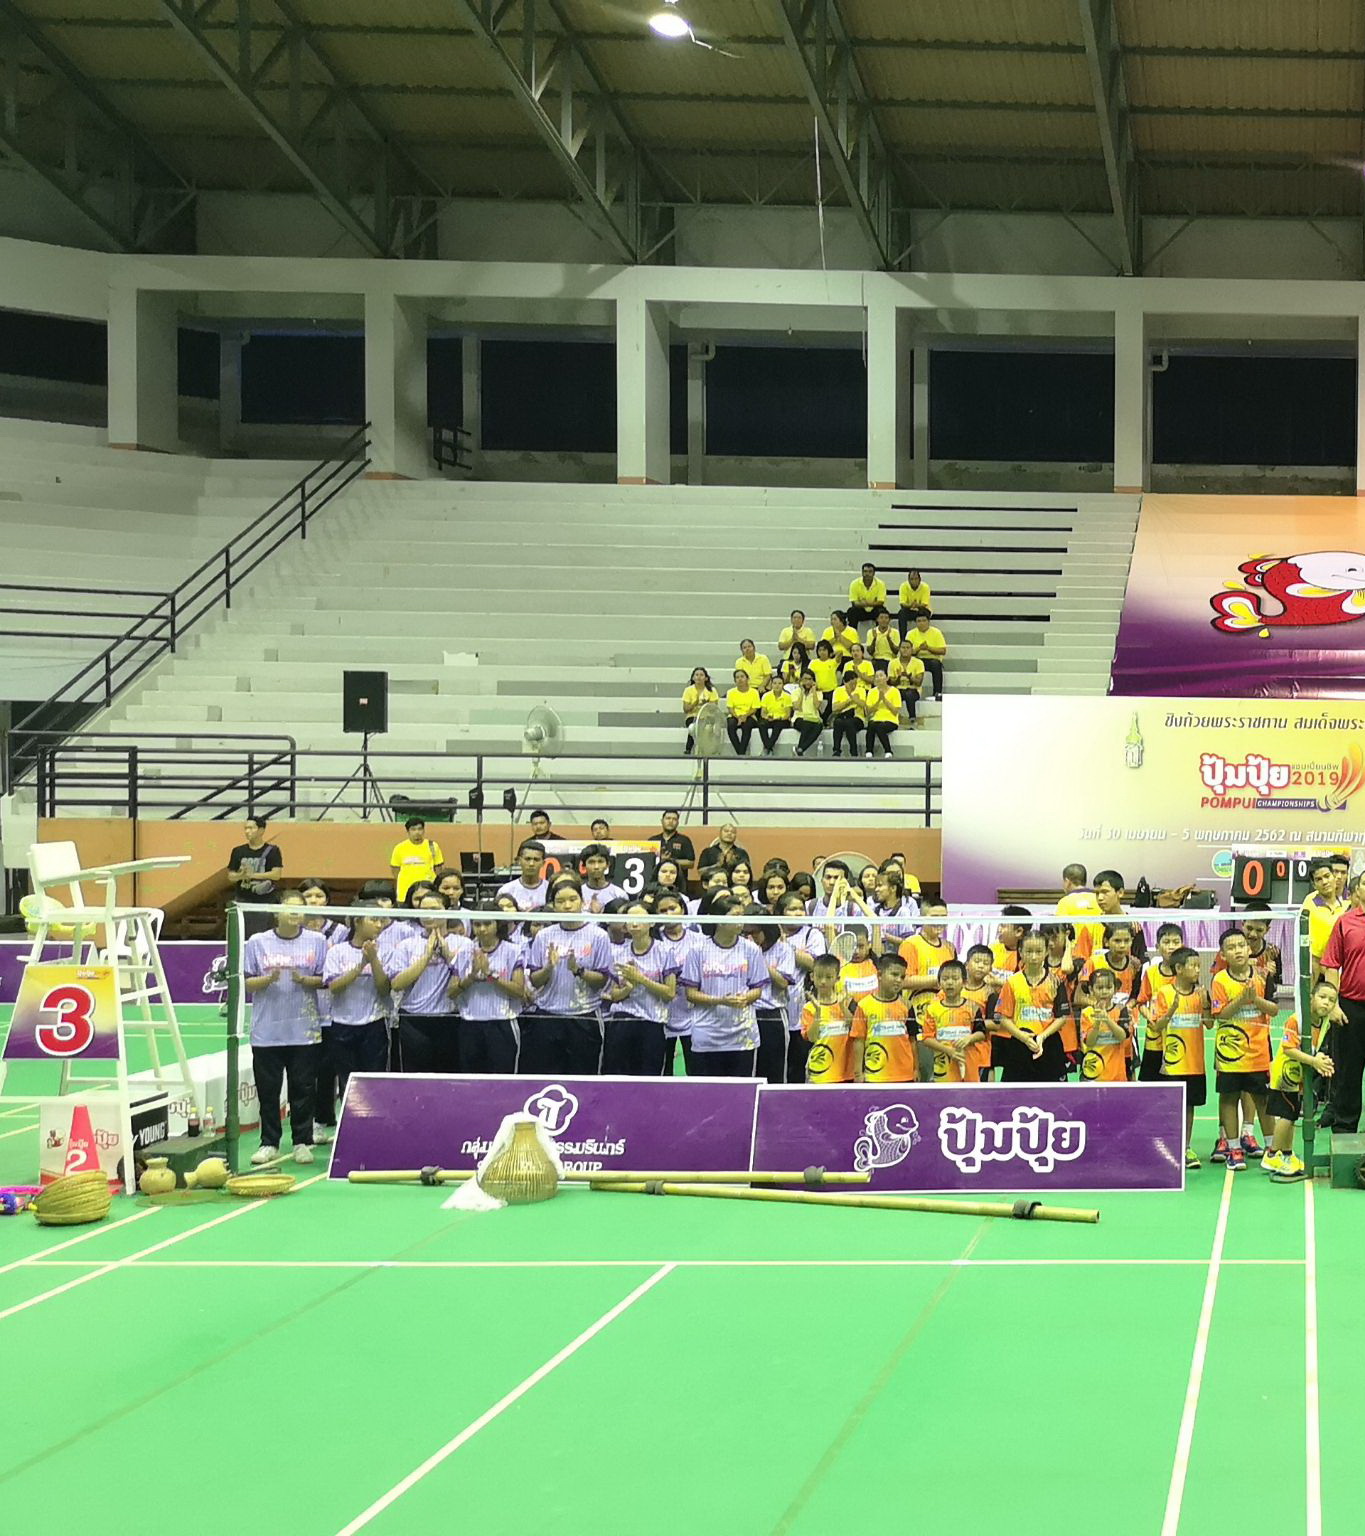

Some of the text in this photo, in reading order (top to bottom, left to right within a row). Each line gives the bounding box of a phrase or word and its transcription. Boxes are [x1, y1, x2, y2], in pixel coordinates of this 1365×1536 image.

[1165, 711, 1287, 729] ชิงถ้วยพระราชทาน
[1200, 753, 1290, 796] ปุ้มปุ้ย
[1292, 770, 1340, 786] 2019
[1200, 797, 1316, 809] POMPUI CHAMPIONSHIPS
[1181, 828, 1191, 841] 5
[1254, 828, 1286, 842] 2562
[622, 857, 645, 895] 3
[1242, 860, 1264, 896] 0
[1276, 861, 1286, 877] 0
[1298, 861, 1307, 877] 0
[35, 983, 95, 1057] 3
[139, 1122, 166, 1147] YOUNG
[938, 1106, 1086, 1173] ปุ้มปุ้ย
[64, 1148, 88, 1177] 2
